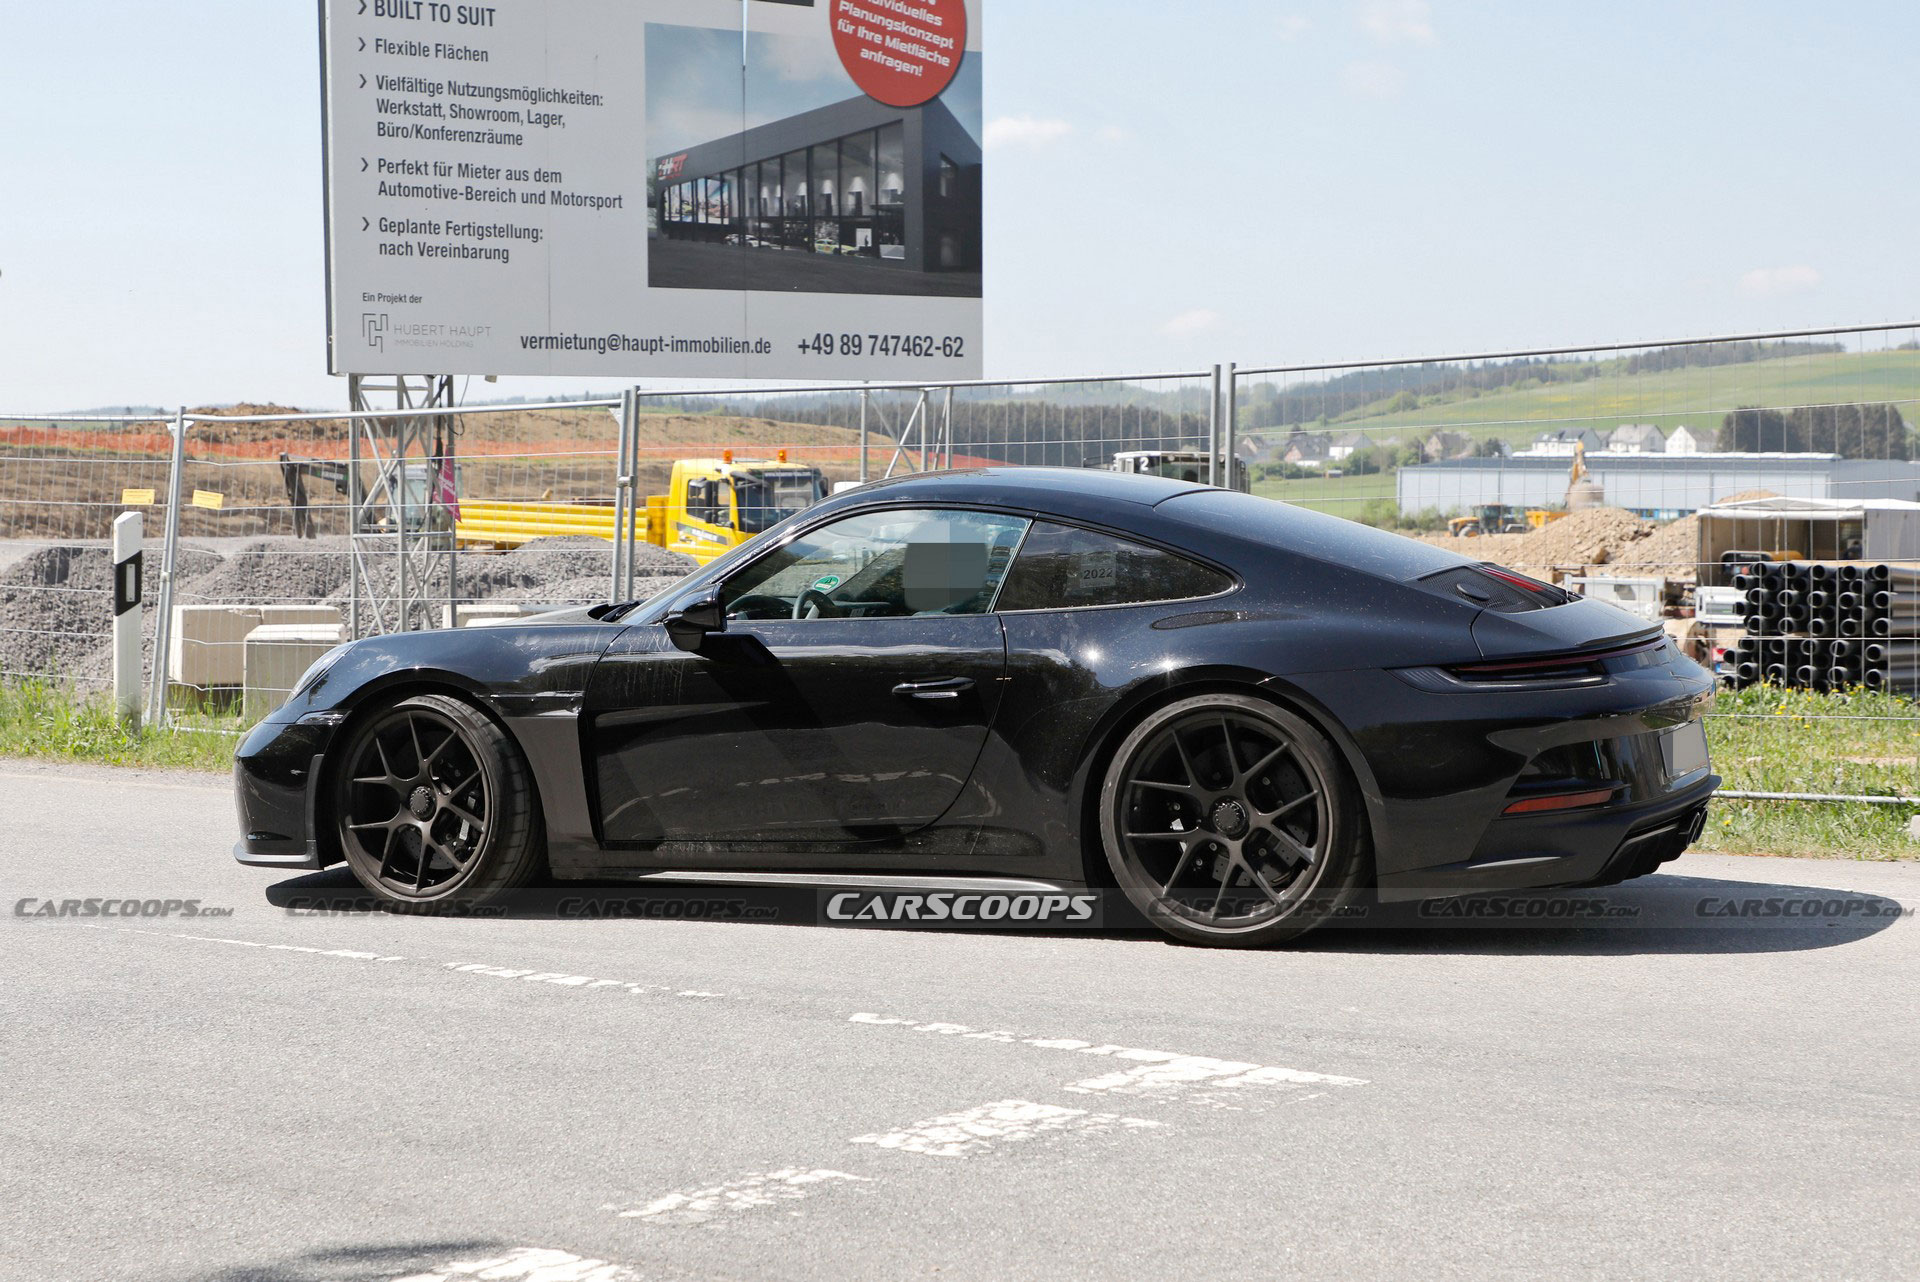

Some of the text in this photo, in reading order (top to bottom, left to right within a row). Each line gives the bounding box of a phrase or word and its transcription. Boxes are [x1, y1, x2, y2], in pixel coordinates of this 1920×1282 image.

[374, 0, 496, 27] BUILT TO SUIT
[838, 1, 954, 49] Planungskonzept
[375, 38, 489, 62] Flexible Flächen
[837, 19, 950, 67] für Ihre Mietfläche
[860, 48, 923, 77] anfragen!
[376, 75, 604, 107] Vielfältige Nutzungsmöglichkeiten:
[376, 98, 566, 128] Werkstatt, Showroom, Lager,
[377, 121, 523, 146] Büro/Konferenzräume
[377, 158, 562, 183] Perfekt für Mieter aus dem
[378, 181, 623, 211] Automotive-Bereich und Motorsport
[379, 217, 543, 243] Geplante Fertigstellung:
[379, 240, 510, 264] nach Vereinbarung
[362, 292, 423, 305] Ein Projekt der
[393, 324, 492, 337] HUBERT HAUPT
[520, 333, 965, 358] vermietung@haupt-immobilien.de +49 89 747462-62
[1140, 456, 1149, 471] 2
[1083, 568, 1113, 580] 2022
[1645, 603, 1653, 615] 6
